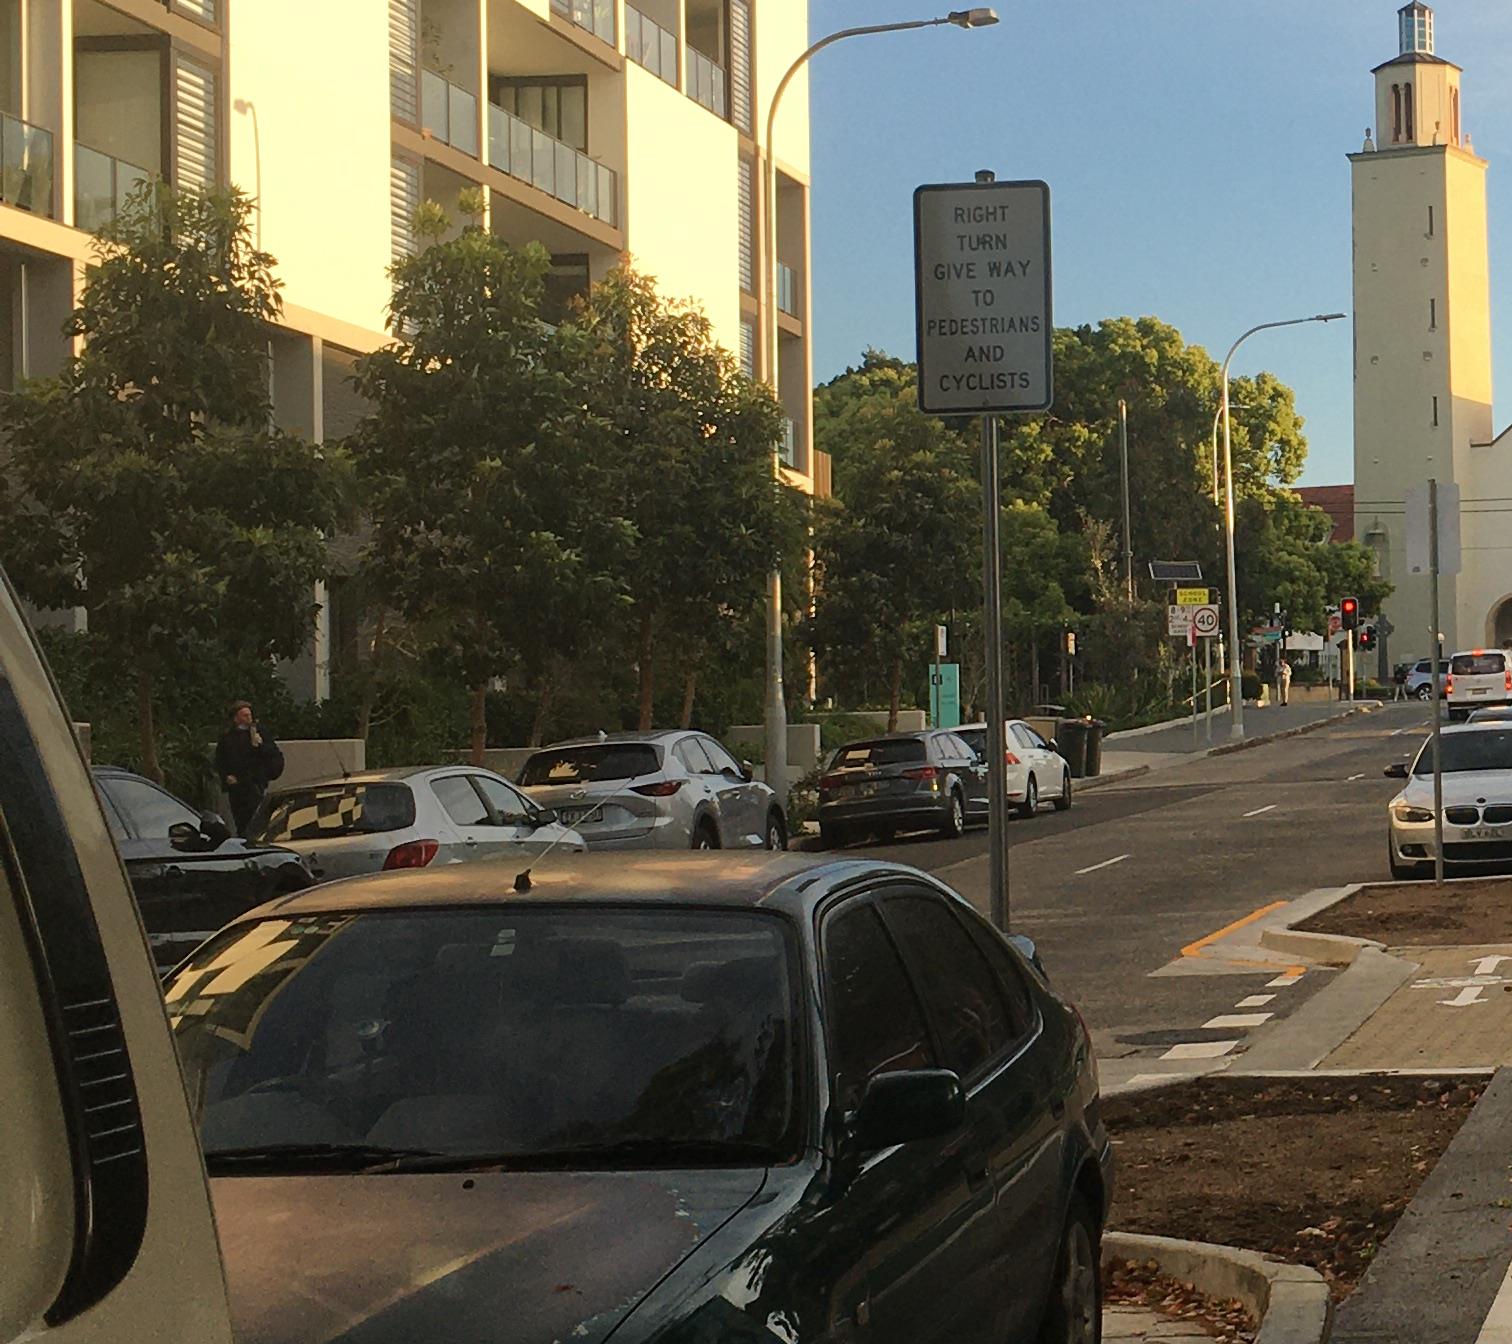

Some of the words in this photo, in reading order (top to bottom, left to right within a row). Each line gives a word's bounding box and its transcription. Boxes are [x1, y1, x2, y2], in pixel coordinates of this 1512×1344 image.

[954, 205, 1009, 224] RIGHT
[957, 234, 1007, 252] TURN
[934, 262, 976, 281] GIVE
[987, 260, 1031, 279] WAY
[971, 289, 995, 307] TO
[927, 316, 1040, 337] PEDESTRIANS
[964, 345, 1005, 363] AND
[940, 371, 1030, 392] CYCLISTS
[1197, 614, 1215, 626] 40
